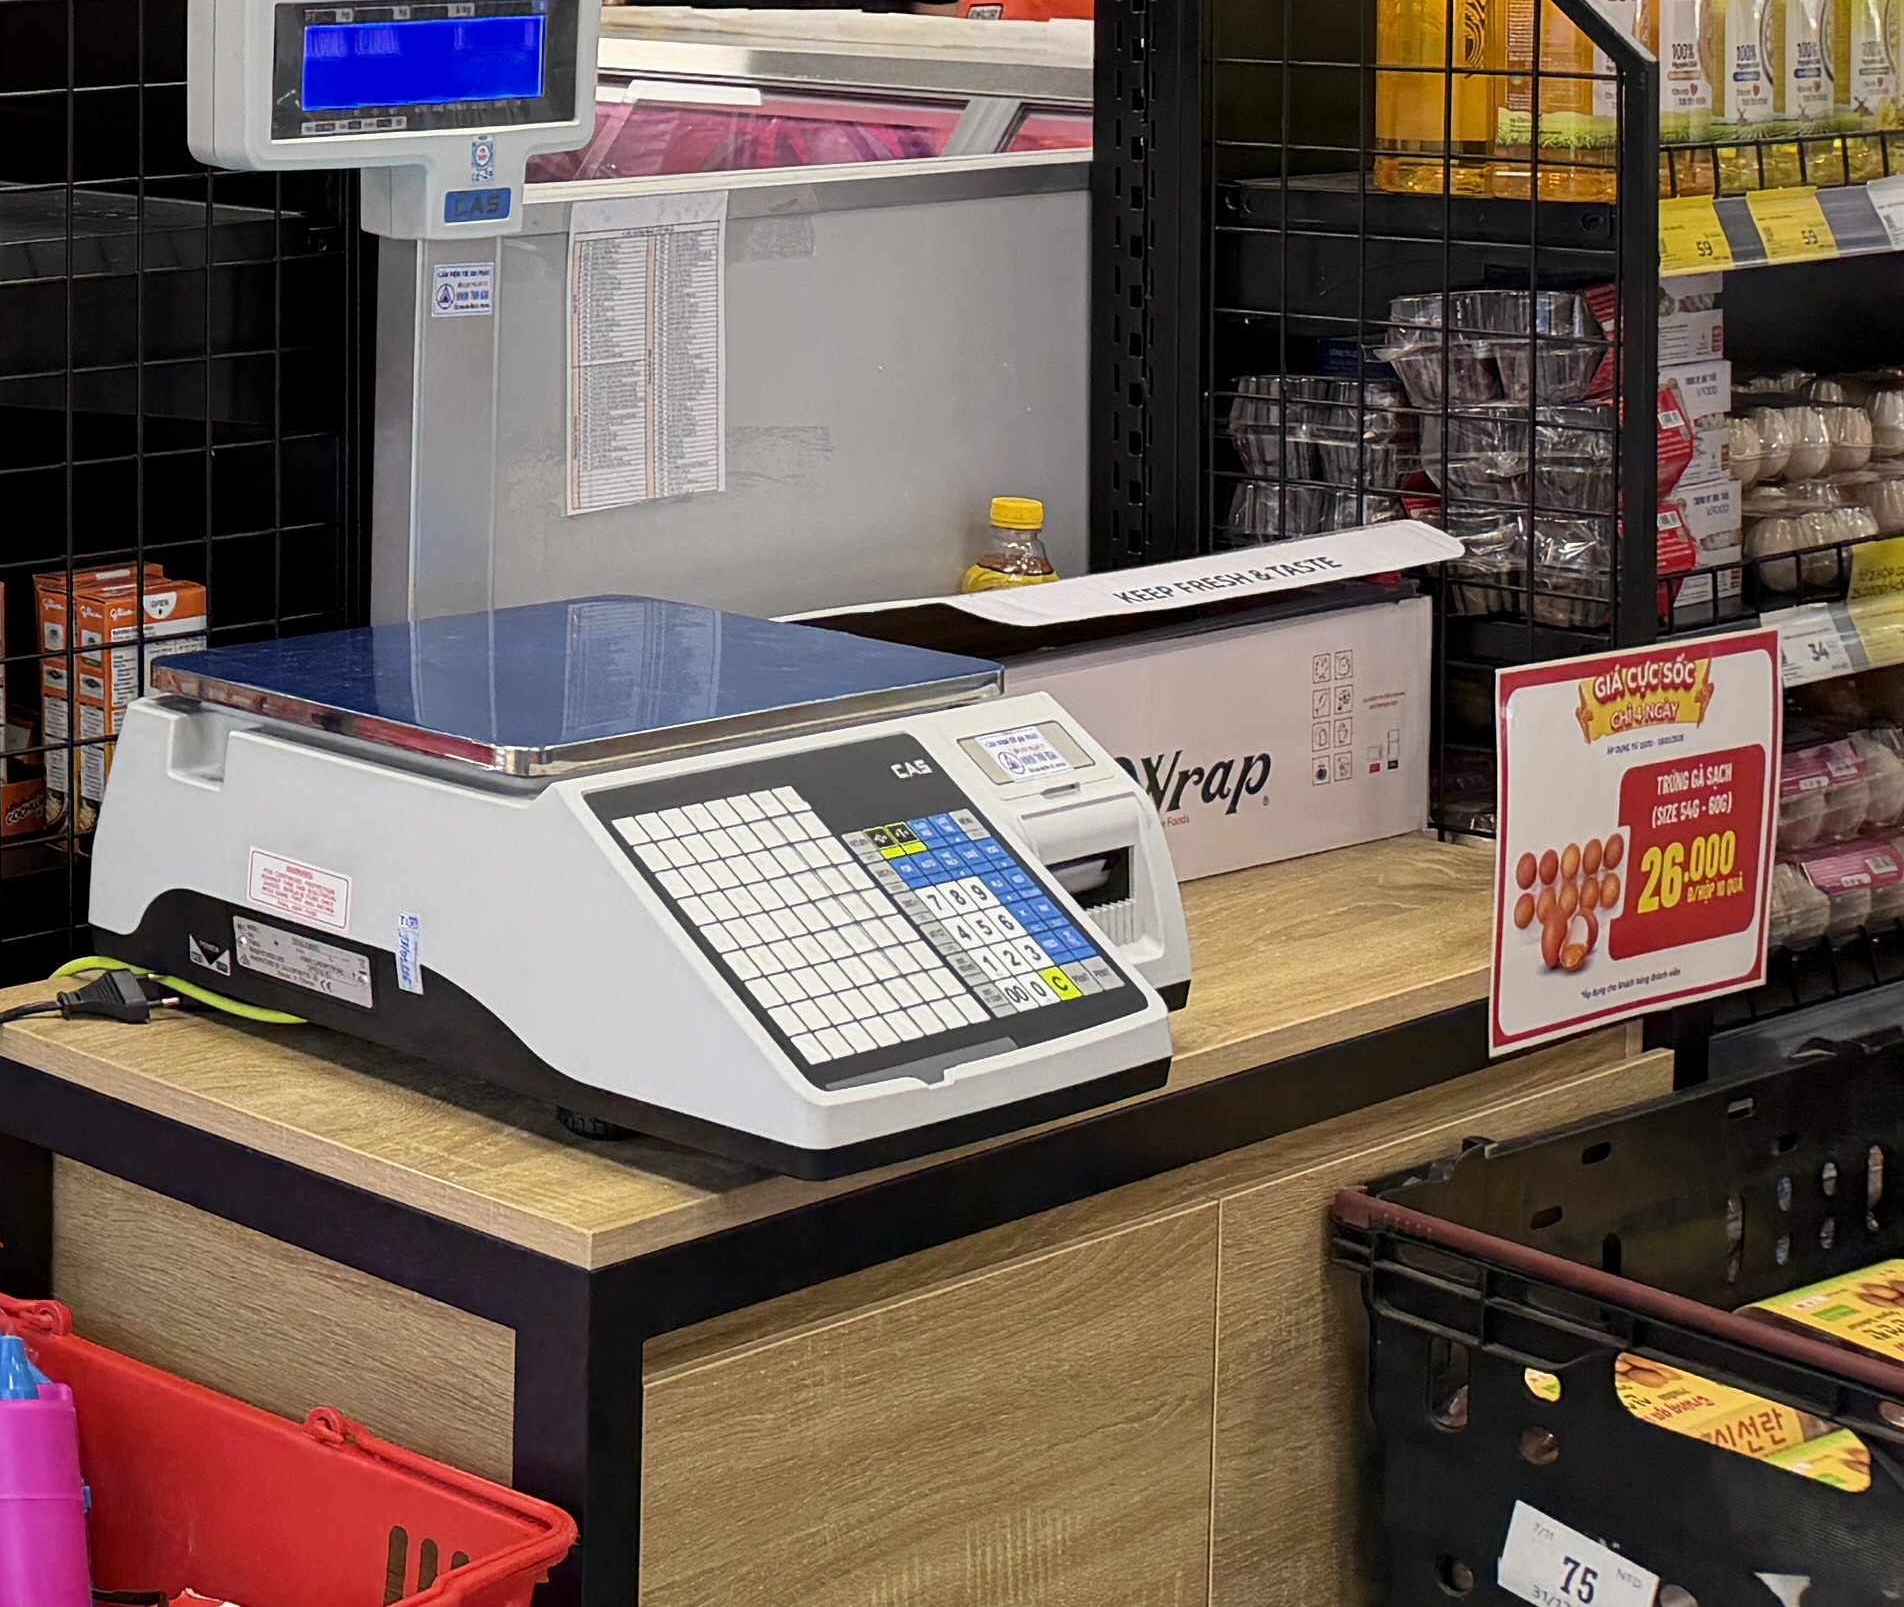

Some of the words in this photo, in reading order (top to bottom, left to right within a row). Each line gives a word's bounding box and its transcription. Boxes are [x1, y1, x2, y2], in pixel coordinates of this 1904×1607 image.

[453, 197, 502, 216] CAS
[1696, 241, 1713, 258] 59
[1114, 584, 1174, 605] KEEP
[1178, 572, 1246, 595] FRESH
[1253, 567, 1272, 583] &
[1272, 555, 1342, 578] TASTE
[1810, 642, 1830, 663] 34
[1594, 665, 1622, 700] GIÁ
[1627, 661, 1659, 693] CỰC
[1663, 653, 1695, 685] SỐC
[891, 759, 933, 778] CAS
[1690, 766, 1705, 788] GÀ
[1708, 763, 1733, 791] SẠCH
[1638, 830, 1736, 914] 26.000
[970, 884, 988, 901] 9
[926, 894, 943, 911] 7
[957, 924, 972, 941] 4
[982, 955, 996, 973] 1
[1003, 949, 1020, 966] 2
[1560, 1555, 1599, 1605] 75
